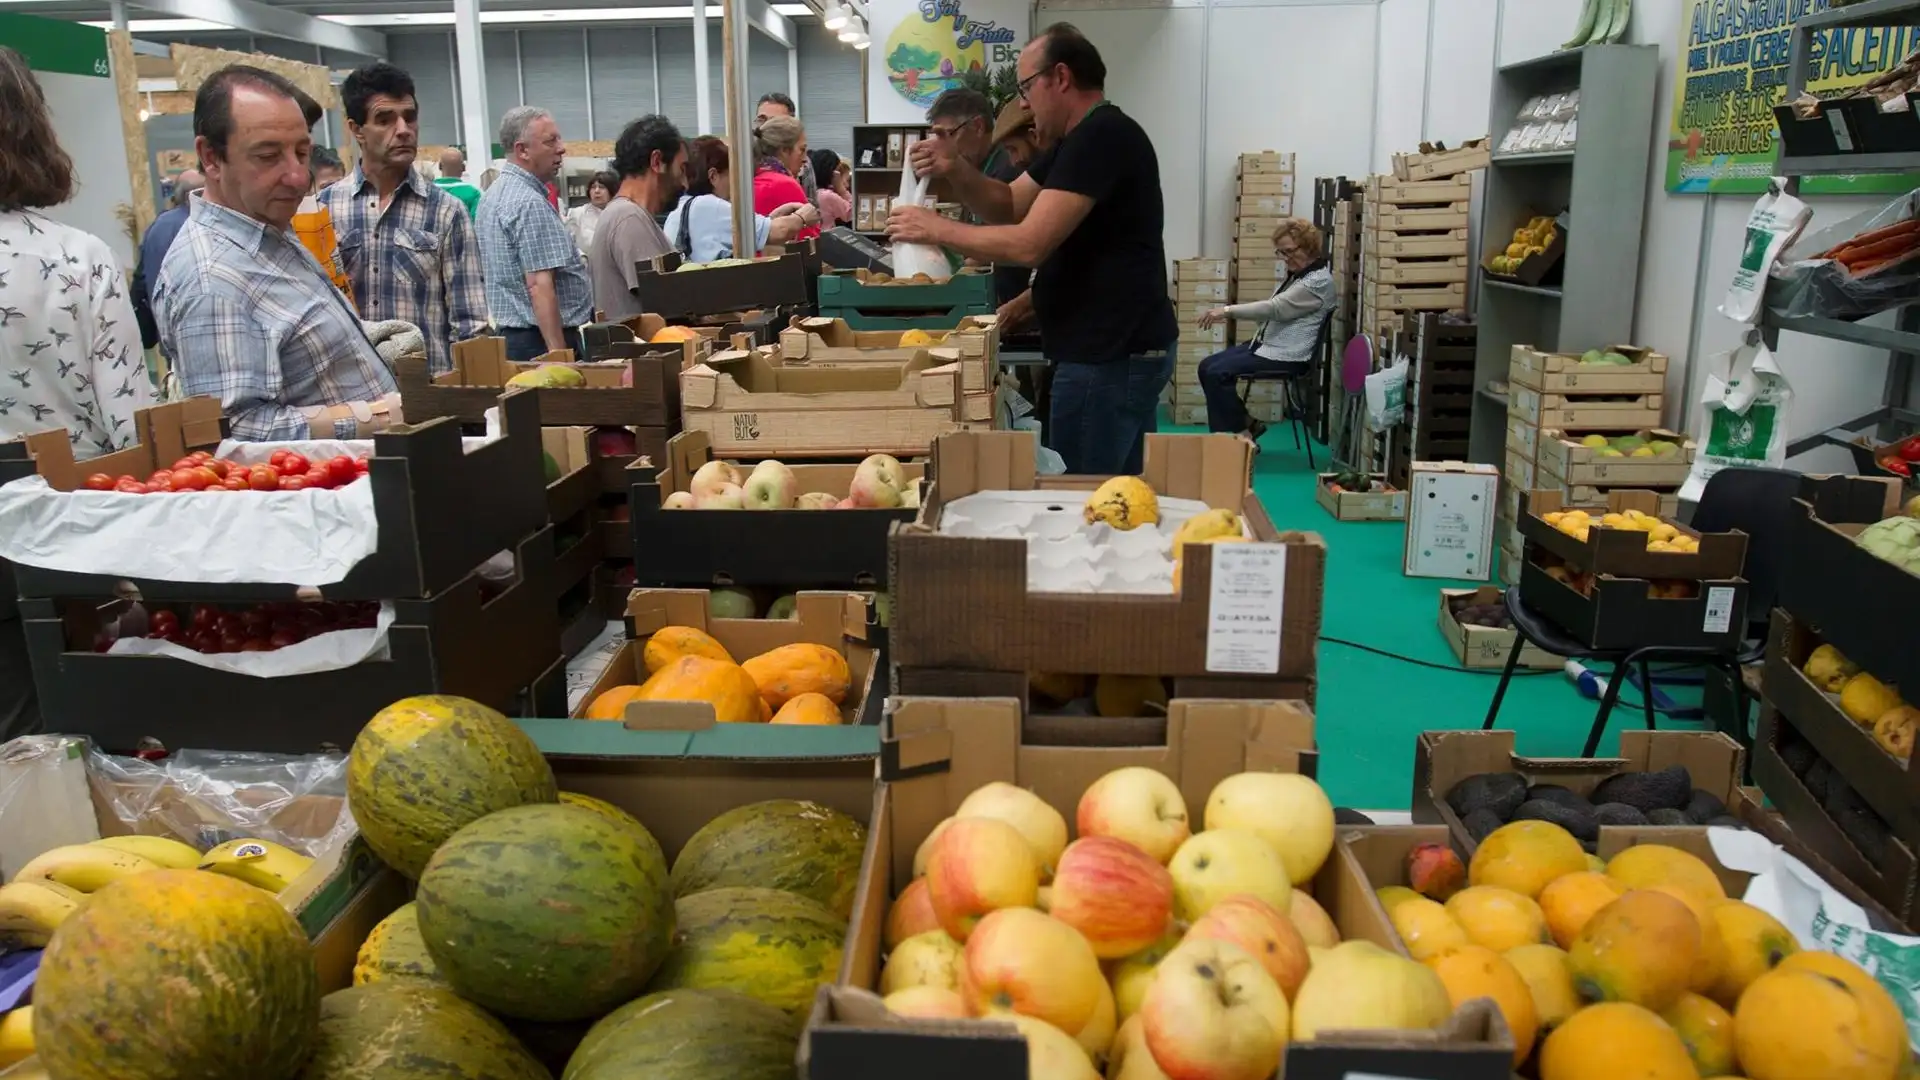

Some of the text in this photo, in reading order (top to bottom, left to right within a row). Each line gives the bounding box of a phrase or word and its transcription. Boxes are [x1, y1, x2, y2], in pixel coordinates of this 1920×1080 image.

[1688, 0, 1747, 46] ALGAS
[94, 58, 108, 75] 66
[1680, 93, 1731, 129] FRUTOS
[1731, 88, 1775, 124] SECOS
[734, 413, 758, 427] NATUR
[734, 426, 749, 439] GUT
